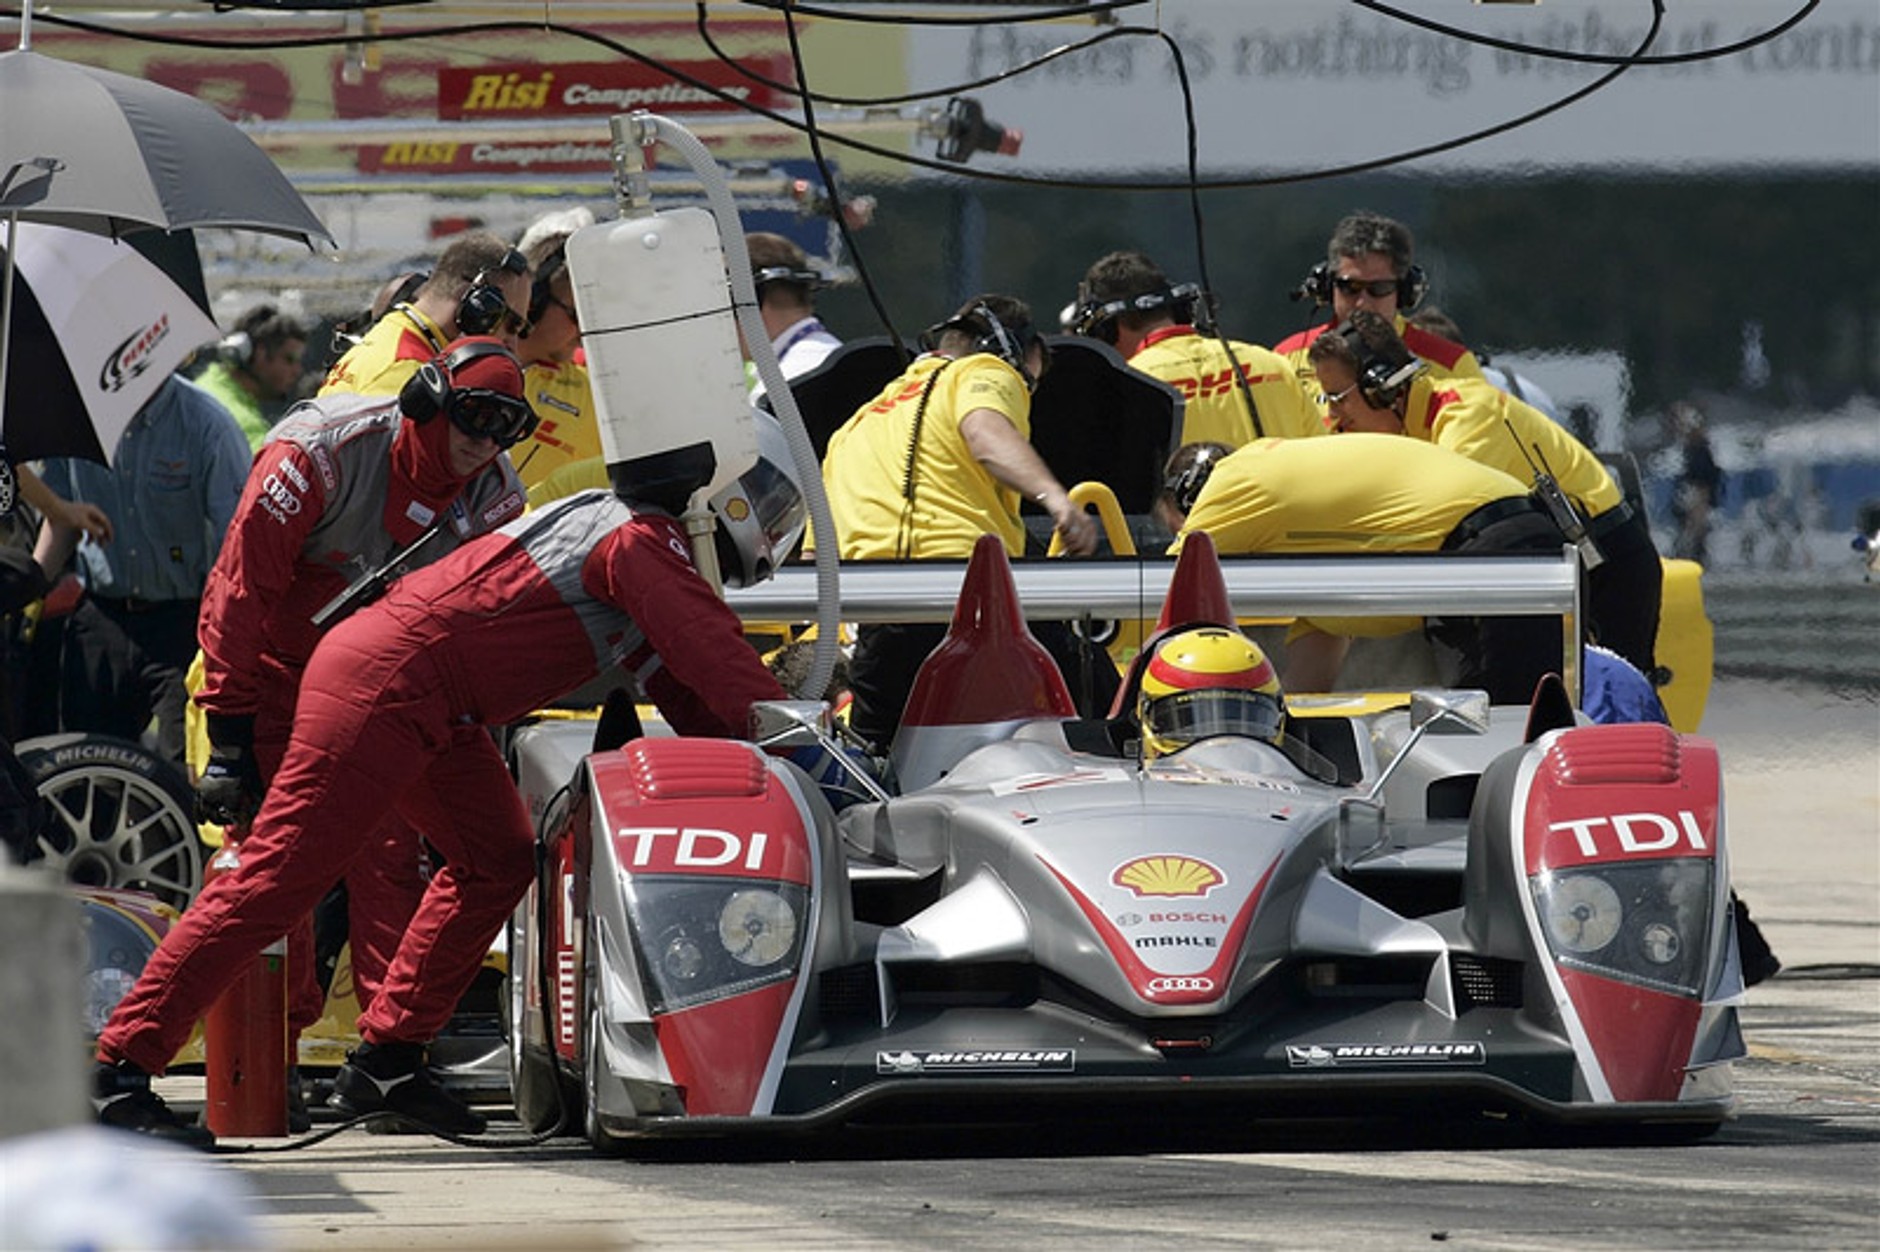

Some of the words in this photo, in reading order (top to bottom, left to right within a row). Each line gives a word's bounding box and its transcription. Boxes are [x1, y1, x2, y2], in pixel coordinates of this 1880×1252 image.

[1234, 14, 1470, 98] nothing
[1740, 19, 1880, 78] cont
[462, 71, 554, 110] Risi
[55, 744, 153, 771] MICHELIN
[1548, 810, 1708, 857] TDI
[618, 827, 768, 871] TDI
[1148, 913, 1227, 924] BOSCH
[1135, 936, 1217, 948] MAHLE
[924, 1051, 1069, 1064] MICHELIN
[1336, 1044, 1477, 1057] MICHELIN
